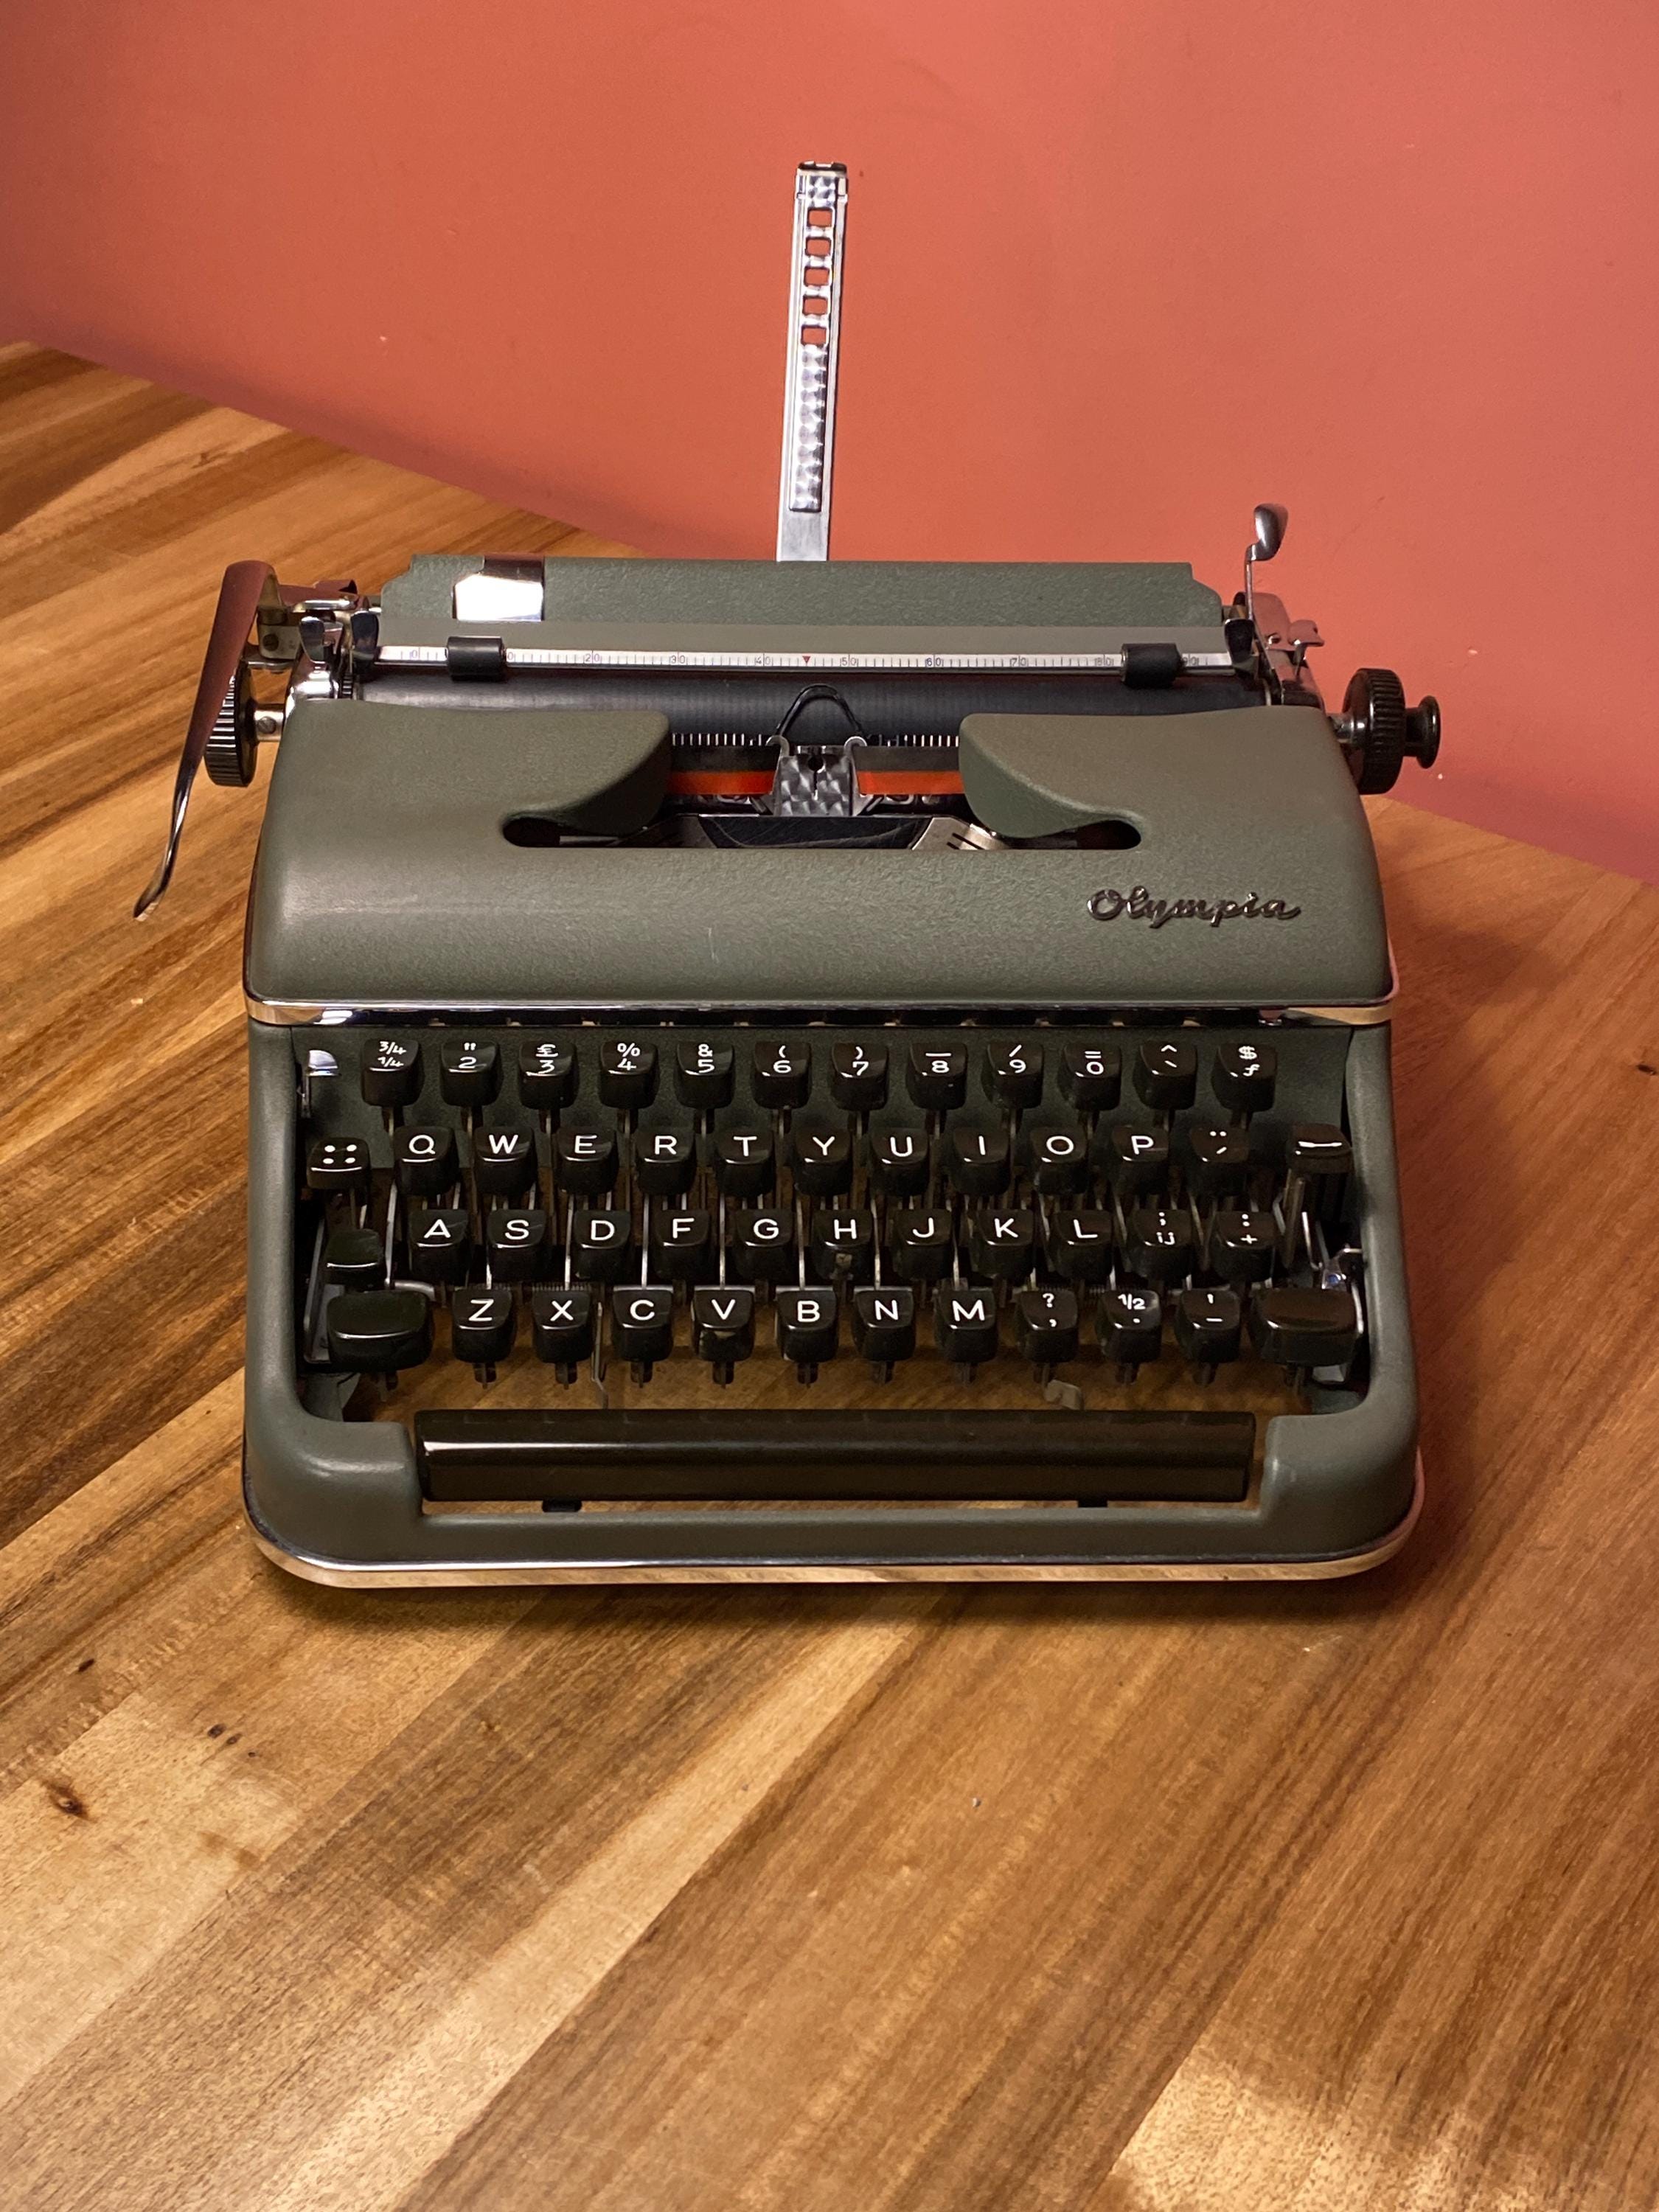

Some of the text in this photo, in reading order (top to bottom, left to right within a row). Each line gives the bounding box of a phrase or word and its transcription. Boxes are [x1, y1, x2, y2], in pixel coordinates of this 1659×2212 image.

[585, 653, 601, 662] 20
[670, 655, 686, 664] 30
[755, 656, 771, 665] 40
[841, 656, 858, 665] 50
[926, 657, 942, 667] 60
[1011, 657, 1028, 667] 70
[1087, 885, 1302, 929] Olympia
[617, 1043, 641, 1057] %
[698, 1043, 713, 1057] &
[1237, 1046, 1257, 1060] $
[458, 1056, 478, 1070] 2
[538, 1059, 557, 1074] 3
[617, 1057, 637, 1071] 4
[698, 1059, 715, 1074] 5
[773, 1060, 792, 1074] 6
[852, 1061, 869, 1077] 7
[931, 1060, 950, 1074] 8
[1009, 1059, 1026, 1074] 9
[408, 1134, 1154, 1157] Q W E R T Y U I O P
[423, 1217, 1098, 1241] A S D F G H J K L
[468, 1298, 985, 1323] Z X C V B N M
[1041, 1293, 1054, 1308] ?
